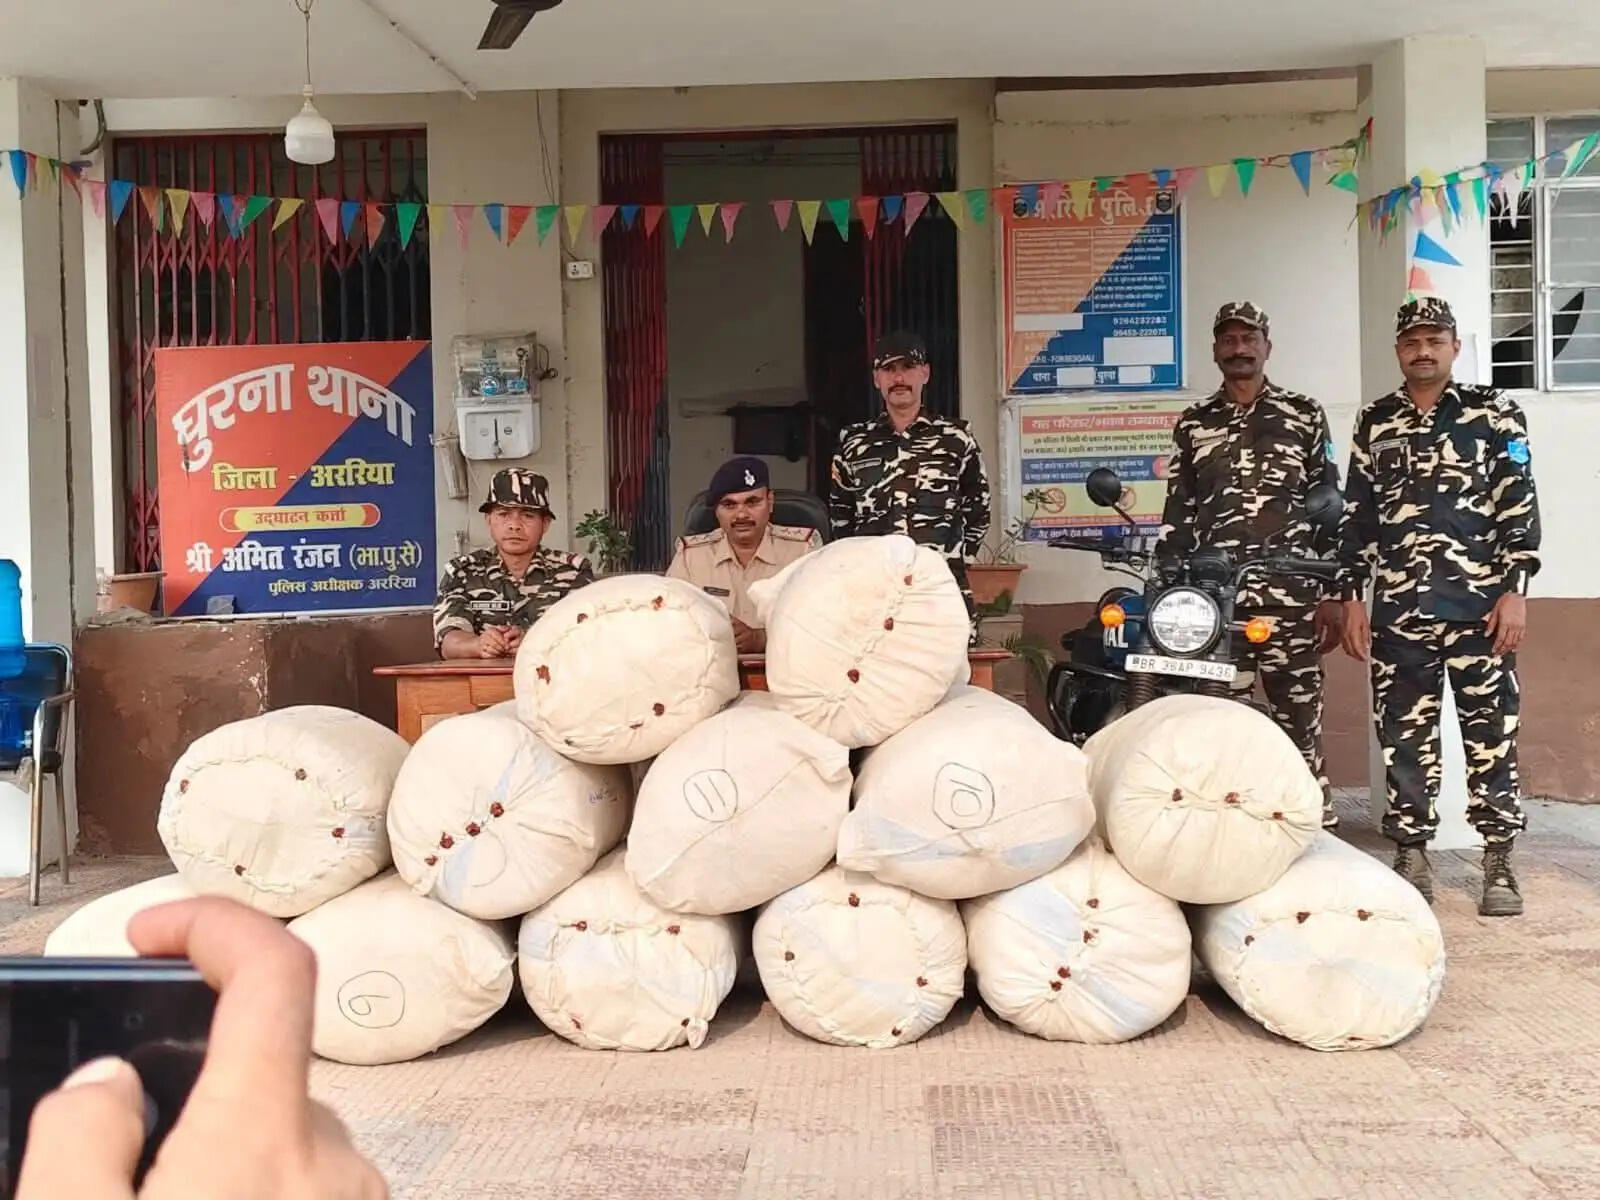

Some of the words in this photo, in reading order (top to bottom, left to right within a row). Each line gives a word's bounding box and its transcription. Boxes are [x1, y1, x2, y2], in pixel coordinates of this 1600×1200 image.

[172, 364, 294, 472] घुरना
[307, 365, 416, 446] थाना
[211, 462, 278, 490] जिला
[310, 458, 396, 487] अररिया
[185, 541, 213, 573] श्री
[221, 540, 285, 573] अमित
[291, 538, 341, 569] रंजन
[268, 579, 306, 597] पुलिस
[310, 577, 363, 593] अधीक्षक
[367, 575, 417, 590] अररिया
[1140, 658, 1156, 670] BR
